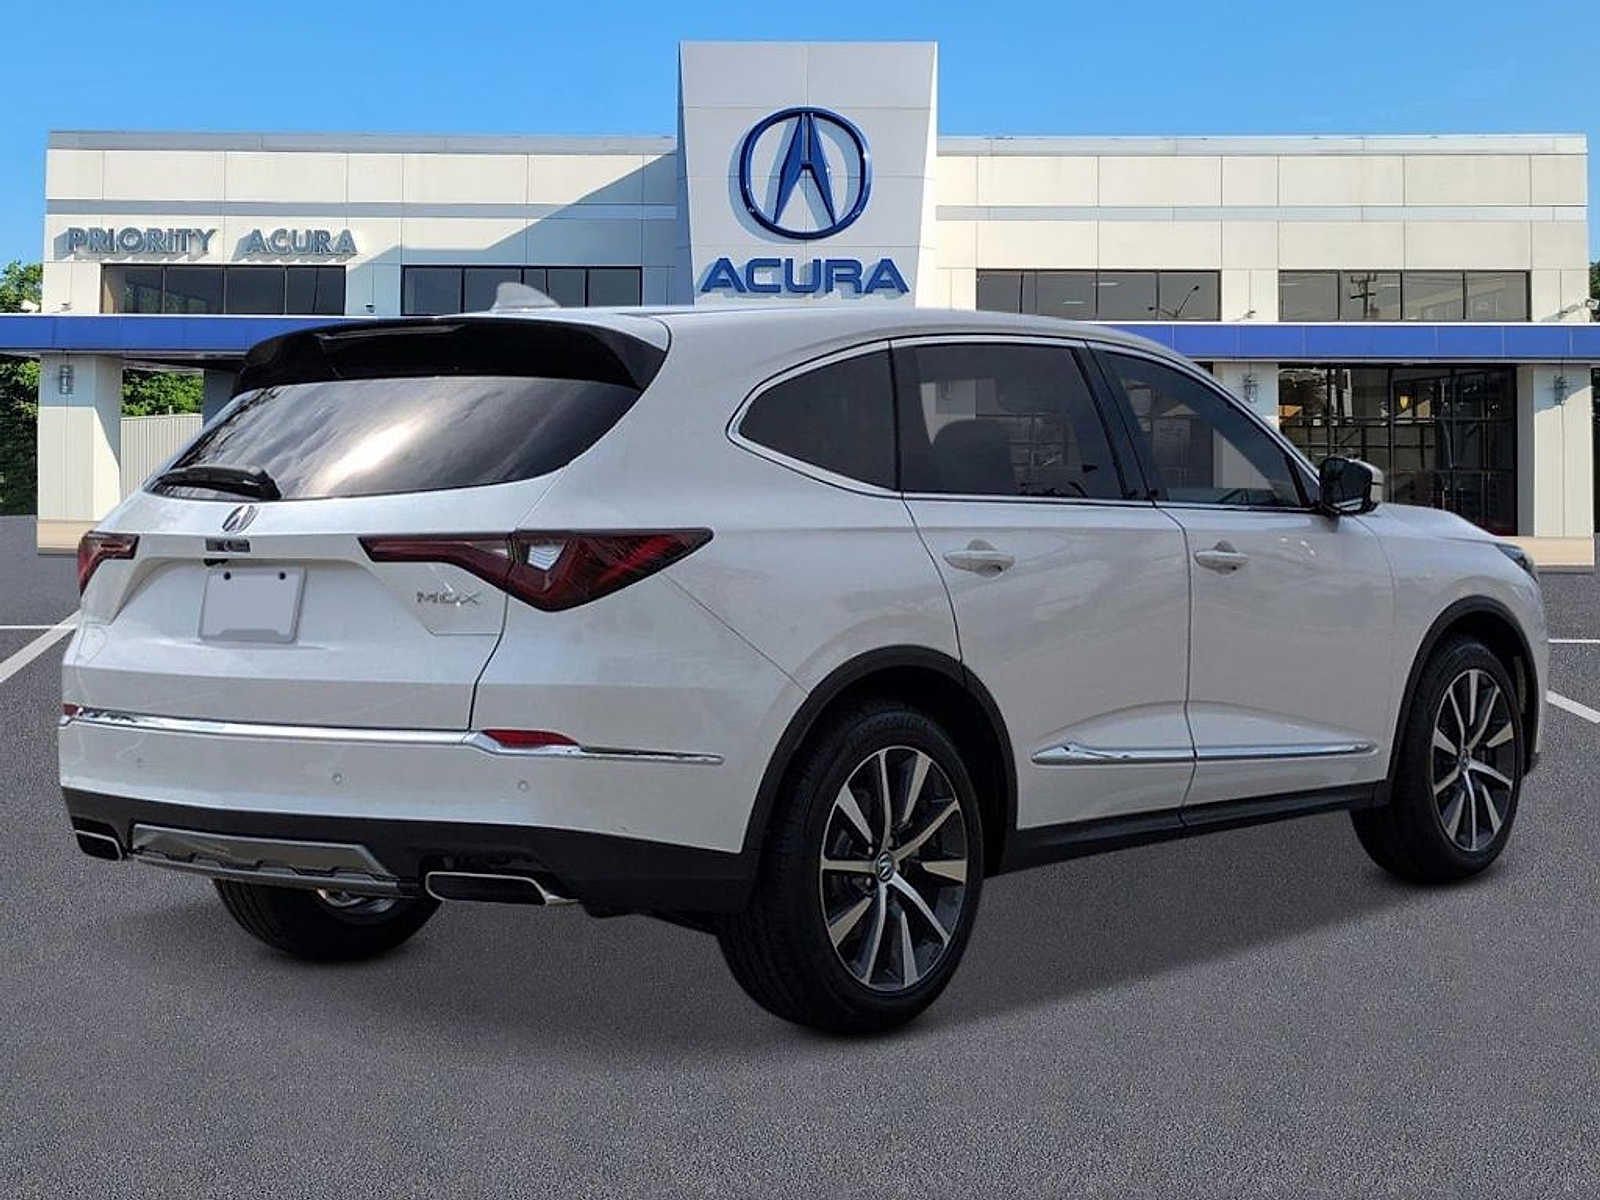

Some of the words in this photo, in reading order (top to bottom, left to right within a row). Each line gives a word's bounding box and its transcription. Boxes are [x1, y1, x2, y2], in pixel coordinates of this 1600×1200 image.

[68, 227, 216, 253] PRIORITY
[248, 228, 357, 255] ACURA
[701, 257, 909, 294] ACURA
